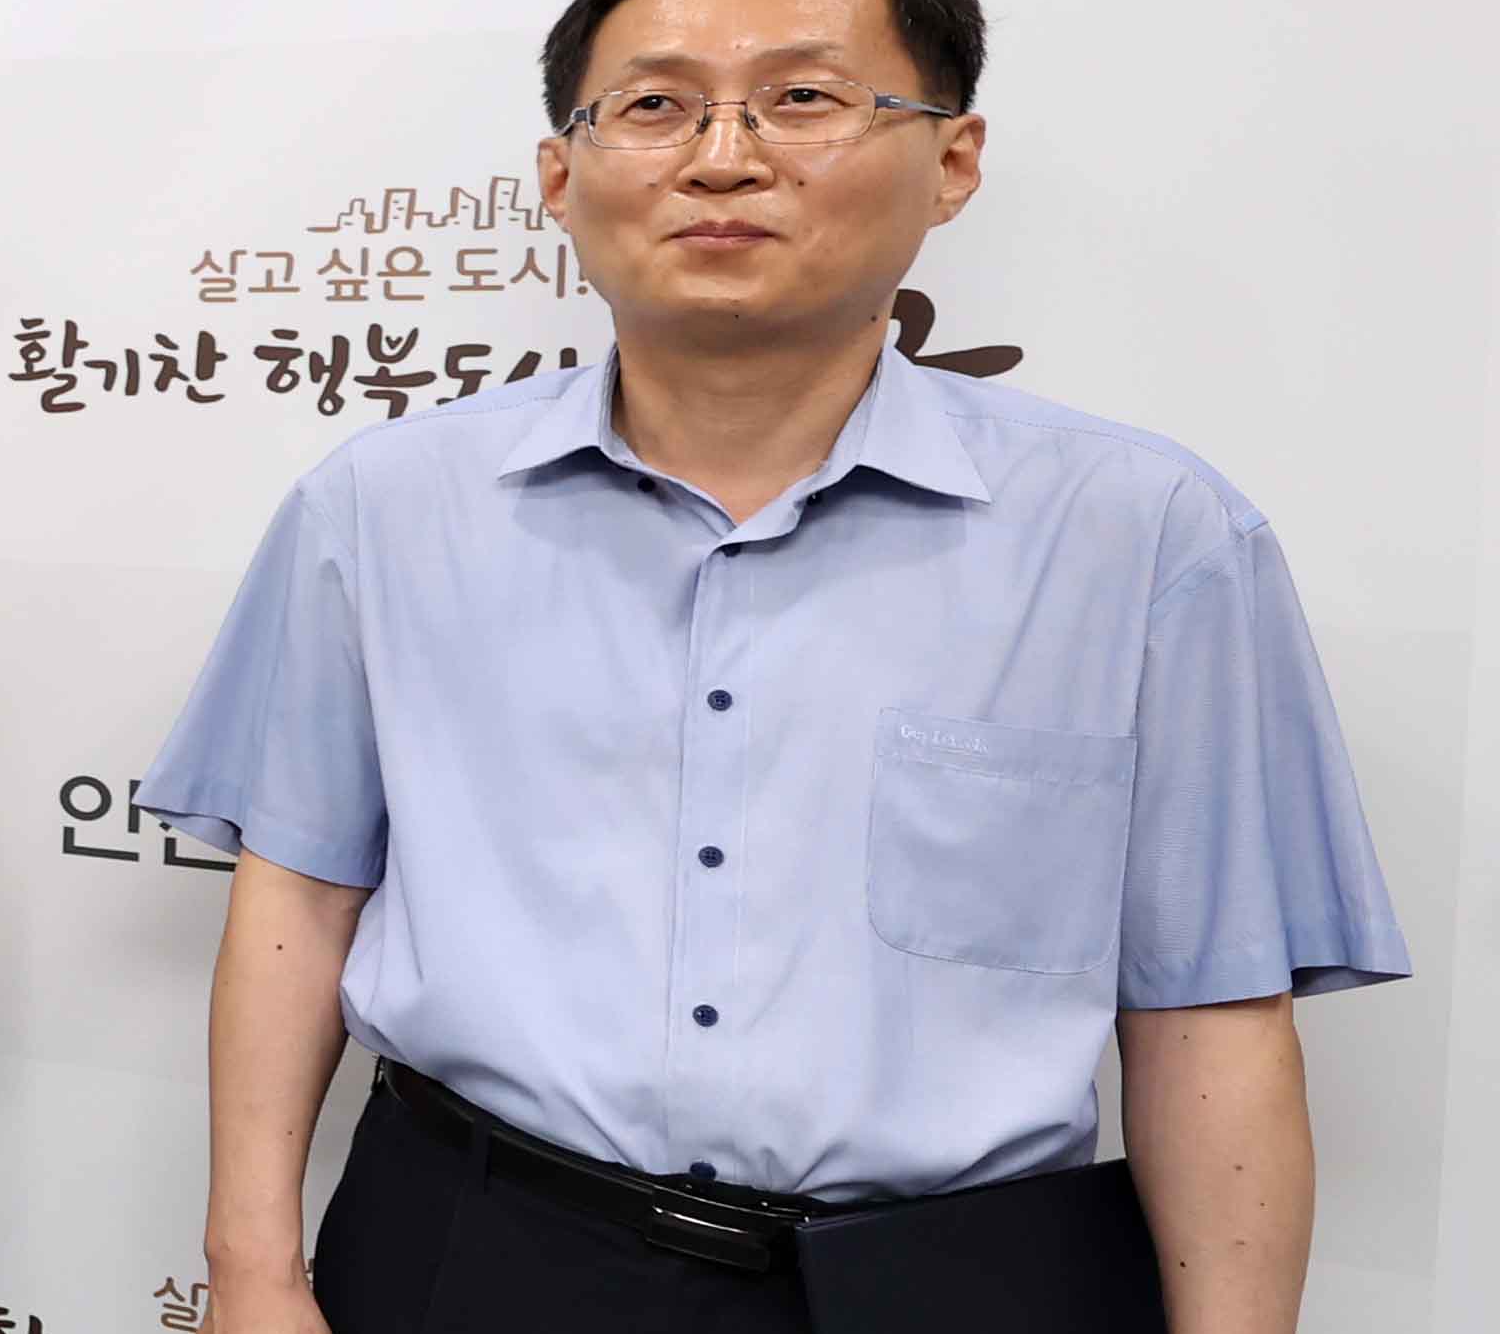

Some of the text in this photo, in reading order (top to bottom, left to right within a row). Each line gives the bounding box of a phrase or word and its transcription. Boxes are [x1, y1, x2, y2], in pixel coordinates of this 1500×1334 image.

[190, 248, 301, 303] 살고
[317, 245, 431, 303] 싶은
[7, 317, 228, 413] 활기찬
